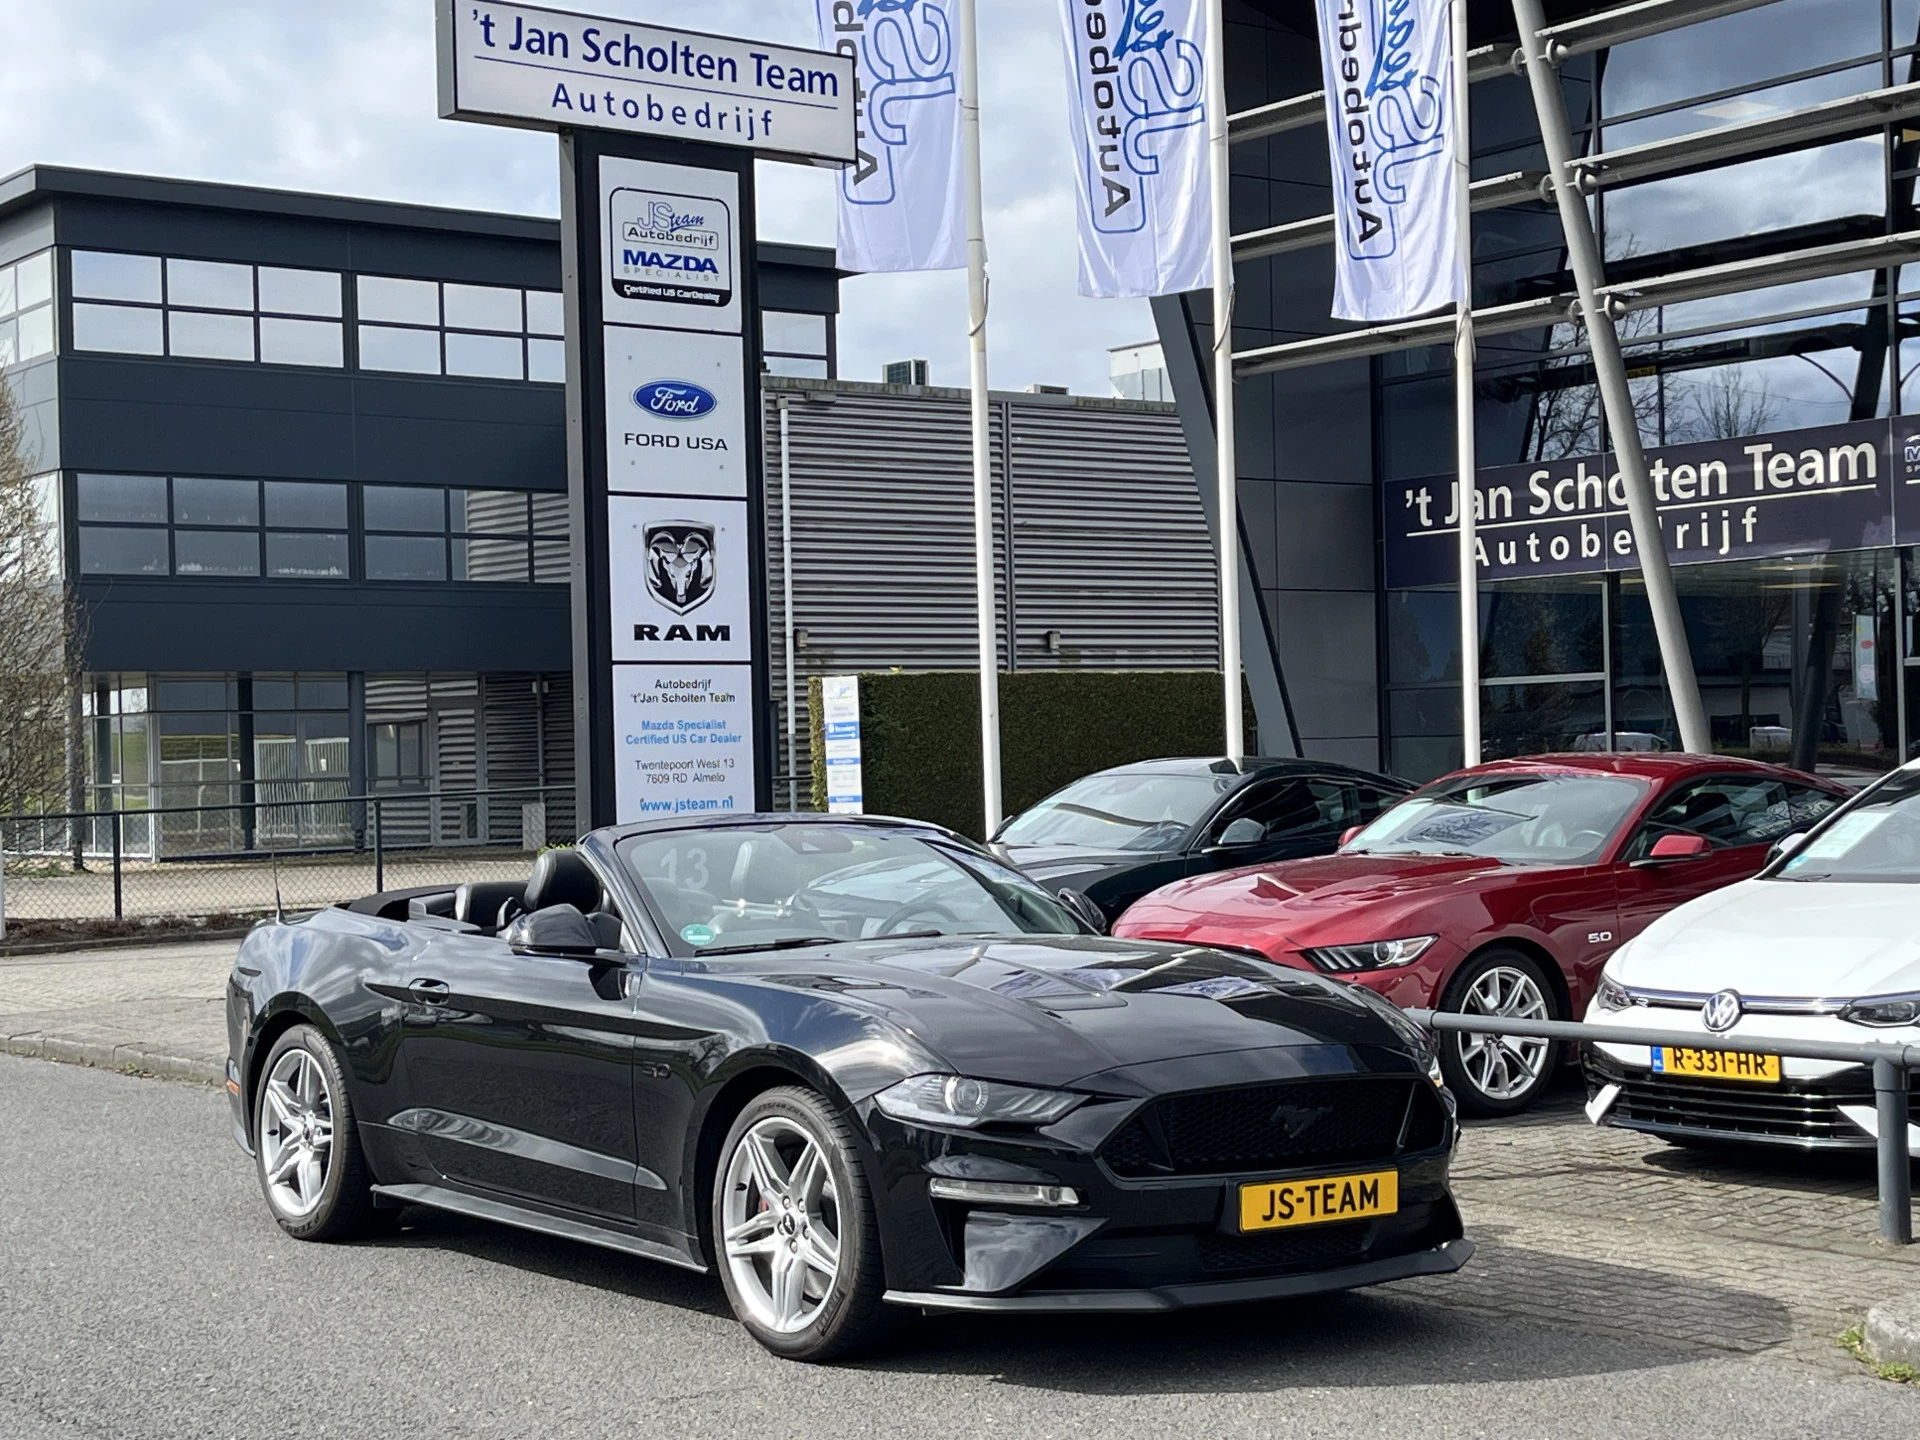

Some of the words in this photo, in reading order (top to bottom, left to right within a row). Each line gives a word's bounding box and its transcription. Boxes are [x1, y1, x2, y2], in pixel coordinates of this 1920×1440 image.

[472, 9, 497, 48] 't
[508, 15, 569, 59] Jan
[582, 28, 738, 83] Scholten
[749, 52, 839, 97] Team
[551, 82, 773, 140] Autobedrijf
[628, 227, 714, 247] Autobedrijf
[623, 249, 719, 274] MAZDA
[623, 266, 720, 282] SPECIALIST
[624, 284, 662, 296] Certified
[663, 288, 675, 297] US
[650, 386, 699, 413] Ford
[624, 432, 680, 449] FORD
[686, 436, 728, 451] USA
[1529, 456, 1728, 516] Schoten
[1743, 442, 1877, 491] Team
[1474, 506, 1757, 567] Autoberijf
[633, 624, 731, 642] RAM
[655, 679, 712, 691] Autobedrijf
[640, 693, 659, 703] Jan
[661, 692, 706, 703] Scholten
[709, 692, 736, 703] Team
[641, 720, 675, 731] Mazda
[677, 719, 727, 732] Specialist
[625, 734, 669, 745] Certified
[672, 734, 687, 744] US
[689, 733, 708, 744] Car
[710, 733, 742, 743] Dealer
[635, 759, 694, 772] Twentepoort
[696, 758, 721, 769] West
[723, 758, 735, 769] 13
[646, 773, 670, 784] 7609
[672, 773, 688, 783] RD
[692, 772, 726, 783] Almelo
[639, 797, 734, 814] www.jsteam.nl
[1672, 1048, 1768, 1076] R-331-HR
[1262, 1178, 1379, 1222] JS-TEAM
